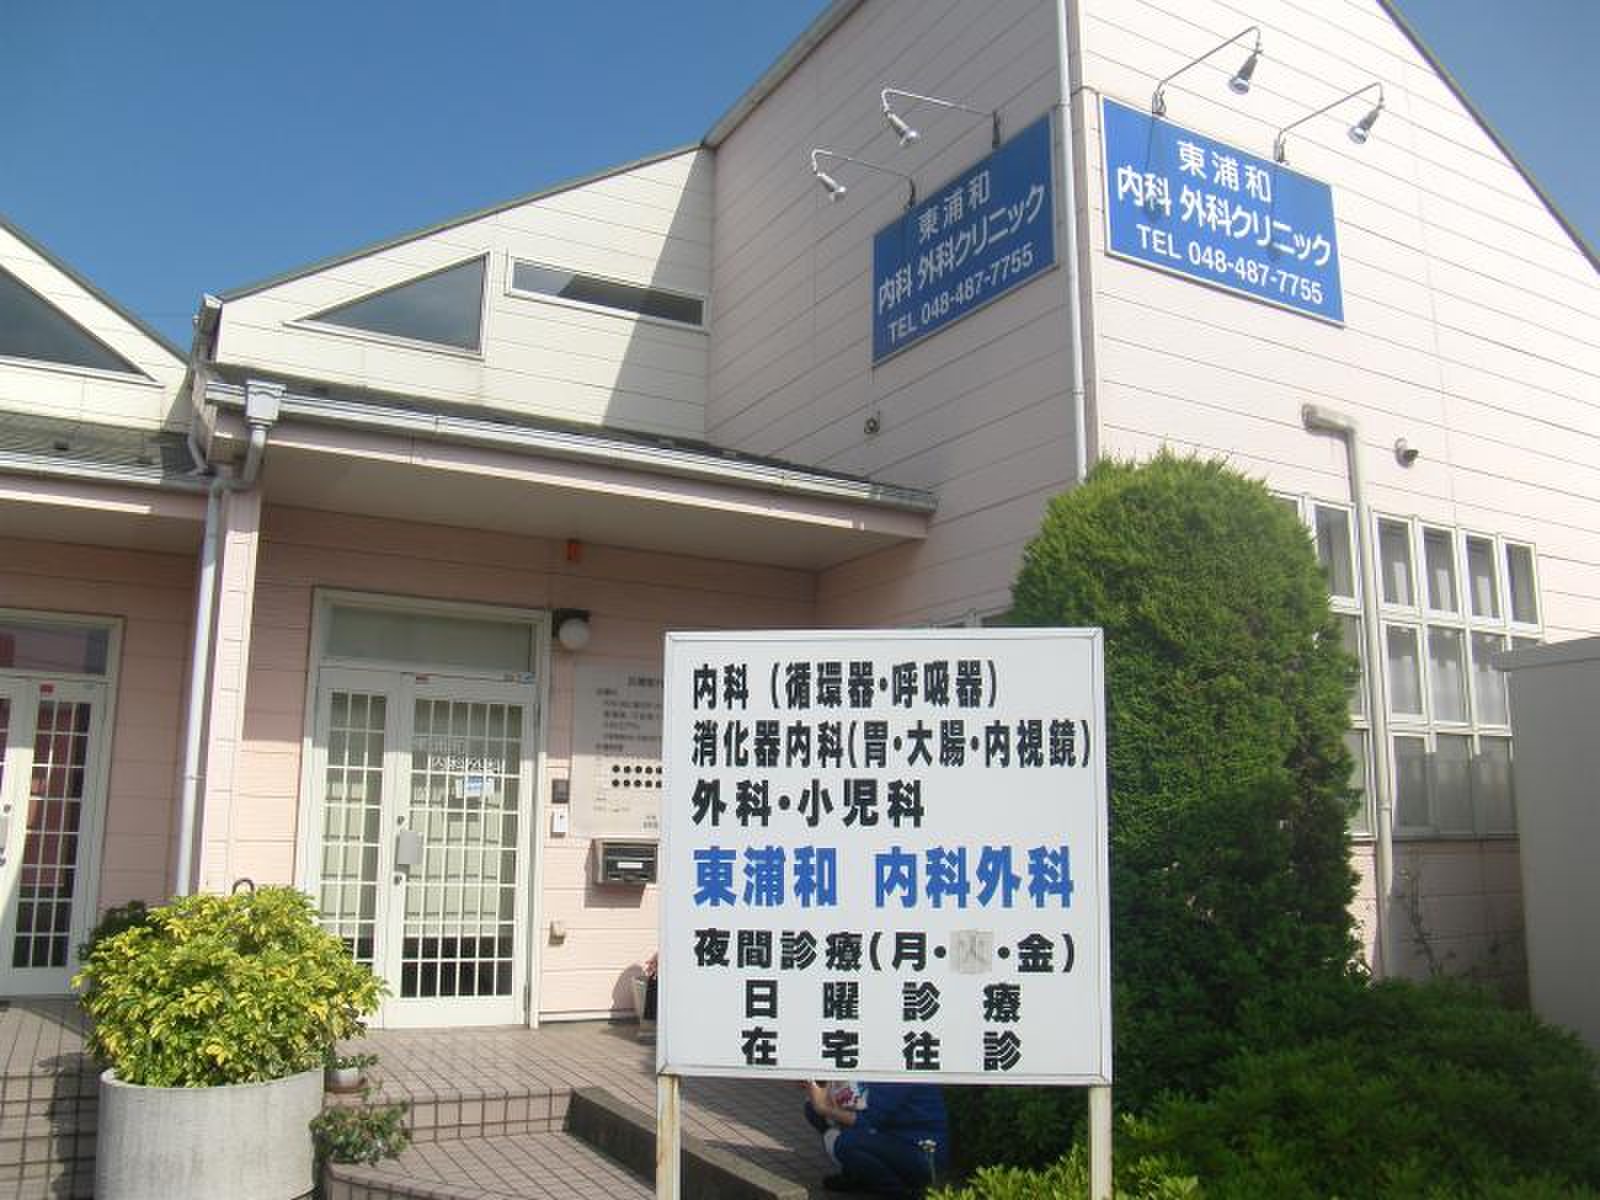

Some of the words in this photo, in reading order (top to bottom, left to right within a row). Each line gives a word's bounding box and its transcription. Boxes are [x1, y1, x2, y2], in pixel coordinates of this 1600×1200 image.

[917, 169, 991, 245] 東浦和
[1177, 140, 1272, 203] 東浦和
[878, 263, 913, 316] 内科
[916, 183, 1045, 290] 外科クリニック
[1117, 164, 1172, 217] 内科
[1179, 184, 1332, 267] 外科クリニック
[887, 312, 918, 344] TEL
[921, 241, 1034, 325] 048-487-7755
[1136, 223, 1183, 260] TEL
[1188, 241, 1324, 305] 048-487-7755
[693, 664, 748, 709] 内科
[694, 846, 836, 907] 東浦和
[876, 846, 1073, 908] 内科外科
